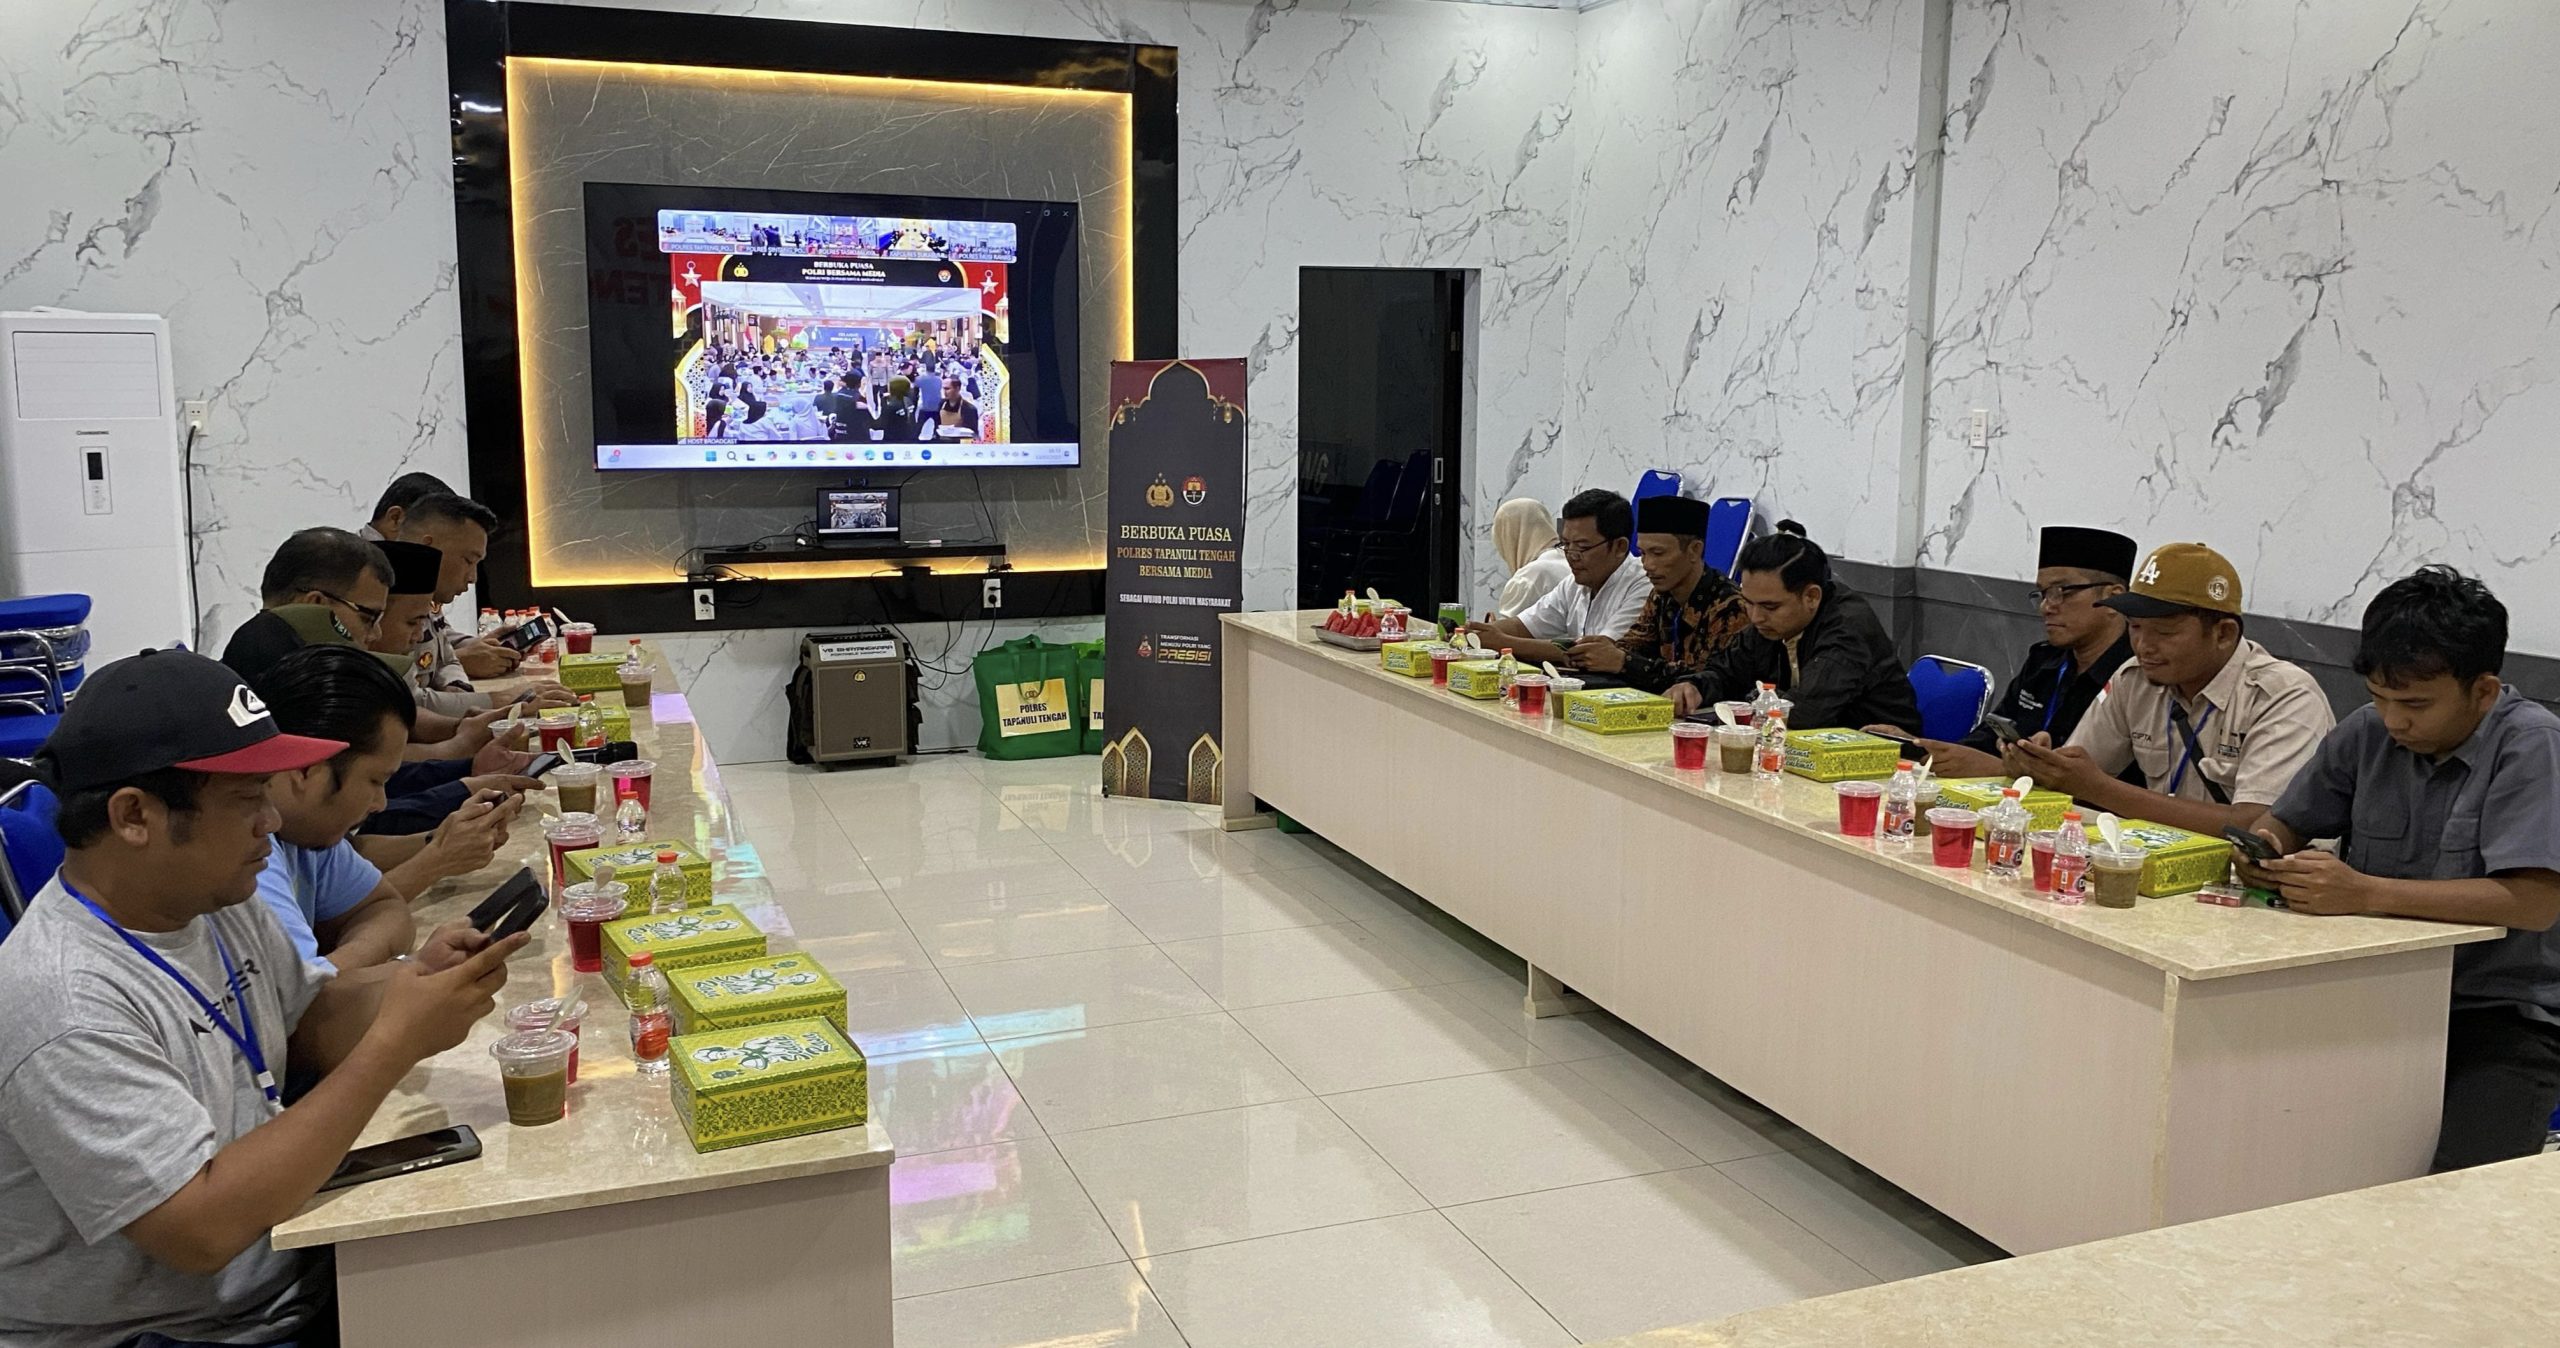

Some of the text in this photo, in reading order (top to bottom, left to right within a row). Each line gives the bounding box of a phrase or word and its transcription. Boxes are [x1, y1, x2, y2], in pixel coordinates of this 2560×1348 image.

[813, 261, 874, 270] BERBUKA PUASA
[801, 268, 886, 278] POLRI BERSAMA MEDIA
[1120, 525, 1232, 542] BERBUKA PUASA
[1117, 547, 1236, 562] POLRES TAPANULI TENGAH
[1139, 565, 1213, 579] BERSAMA MEDIA
[1158, 648, 1212, 661] PRESISI
[1020, 703, 1047, 714] POLRES
[1003, 712, 1067, 727] TAPANULI TENGAH
[1093, 711, 1104, 720] TA
